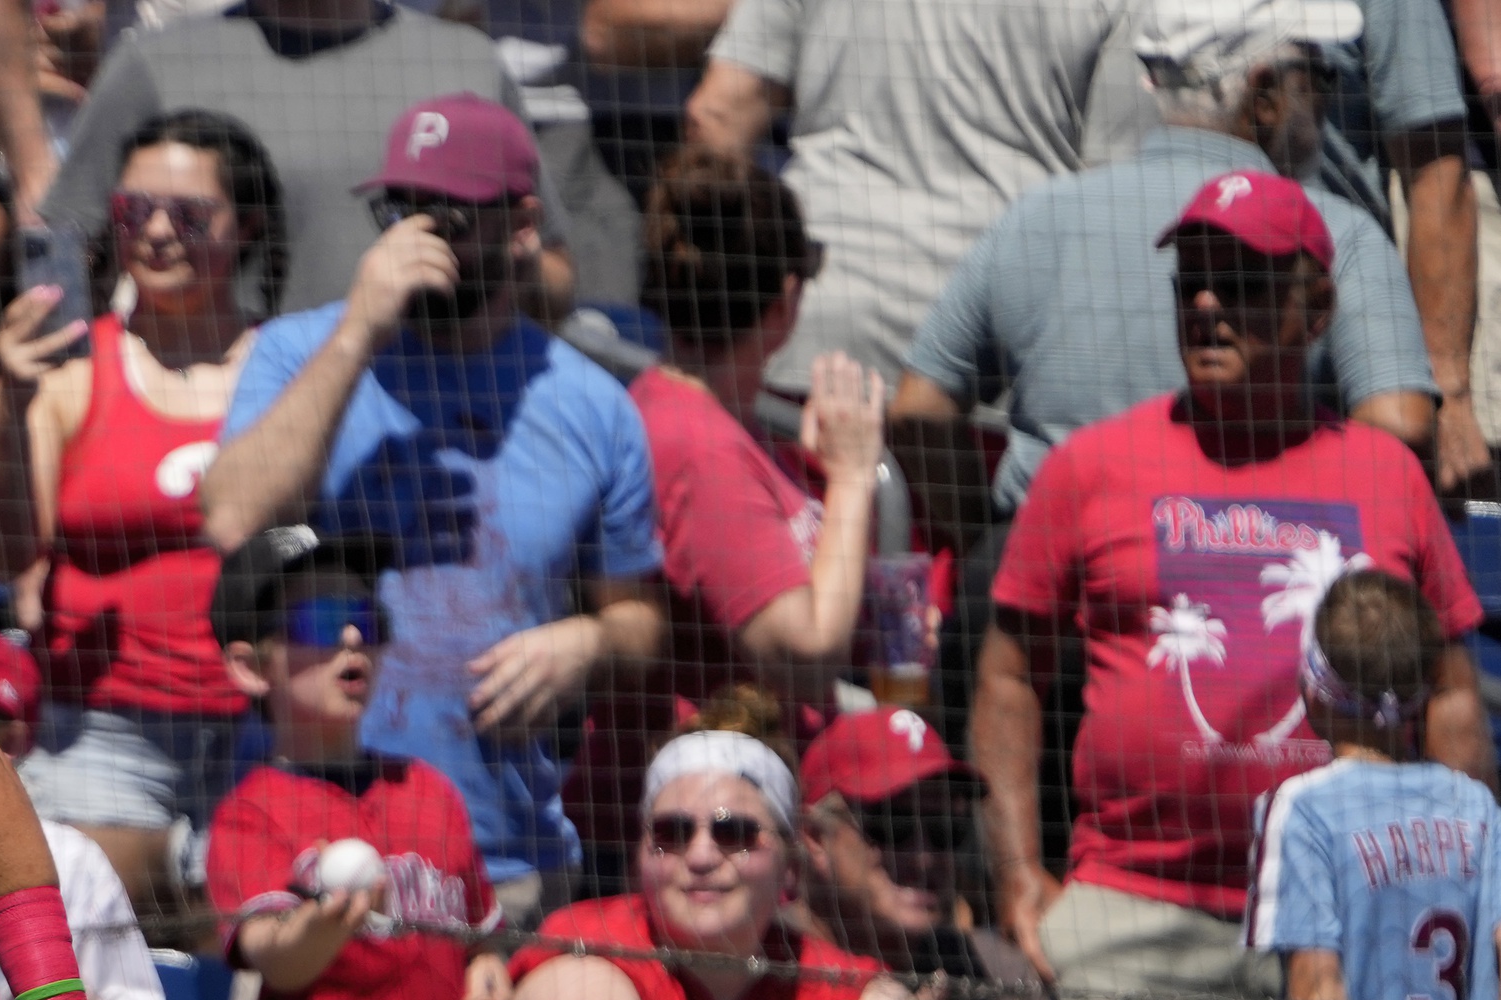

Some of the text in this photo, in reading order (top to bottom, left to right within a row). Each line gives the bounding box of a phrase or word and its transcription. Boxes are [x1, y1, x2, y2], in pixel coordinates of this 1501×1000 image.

[407, 111, 449, 162] P
[1217, 175, 1252, 211] P
[1152, 496, 1320, 554] Phillies
